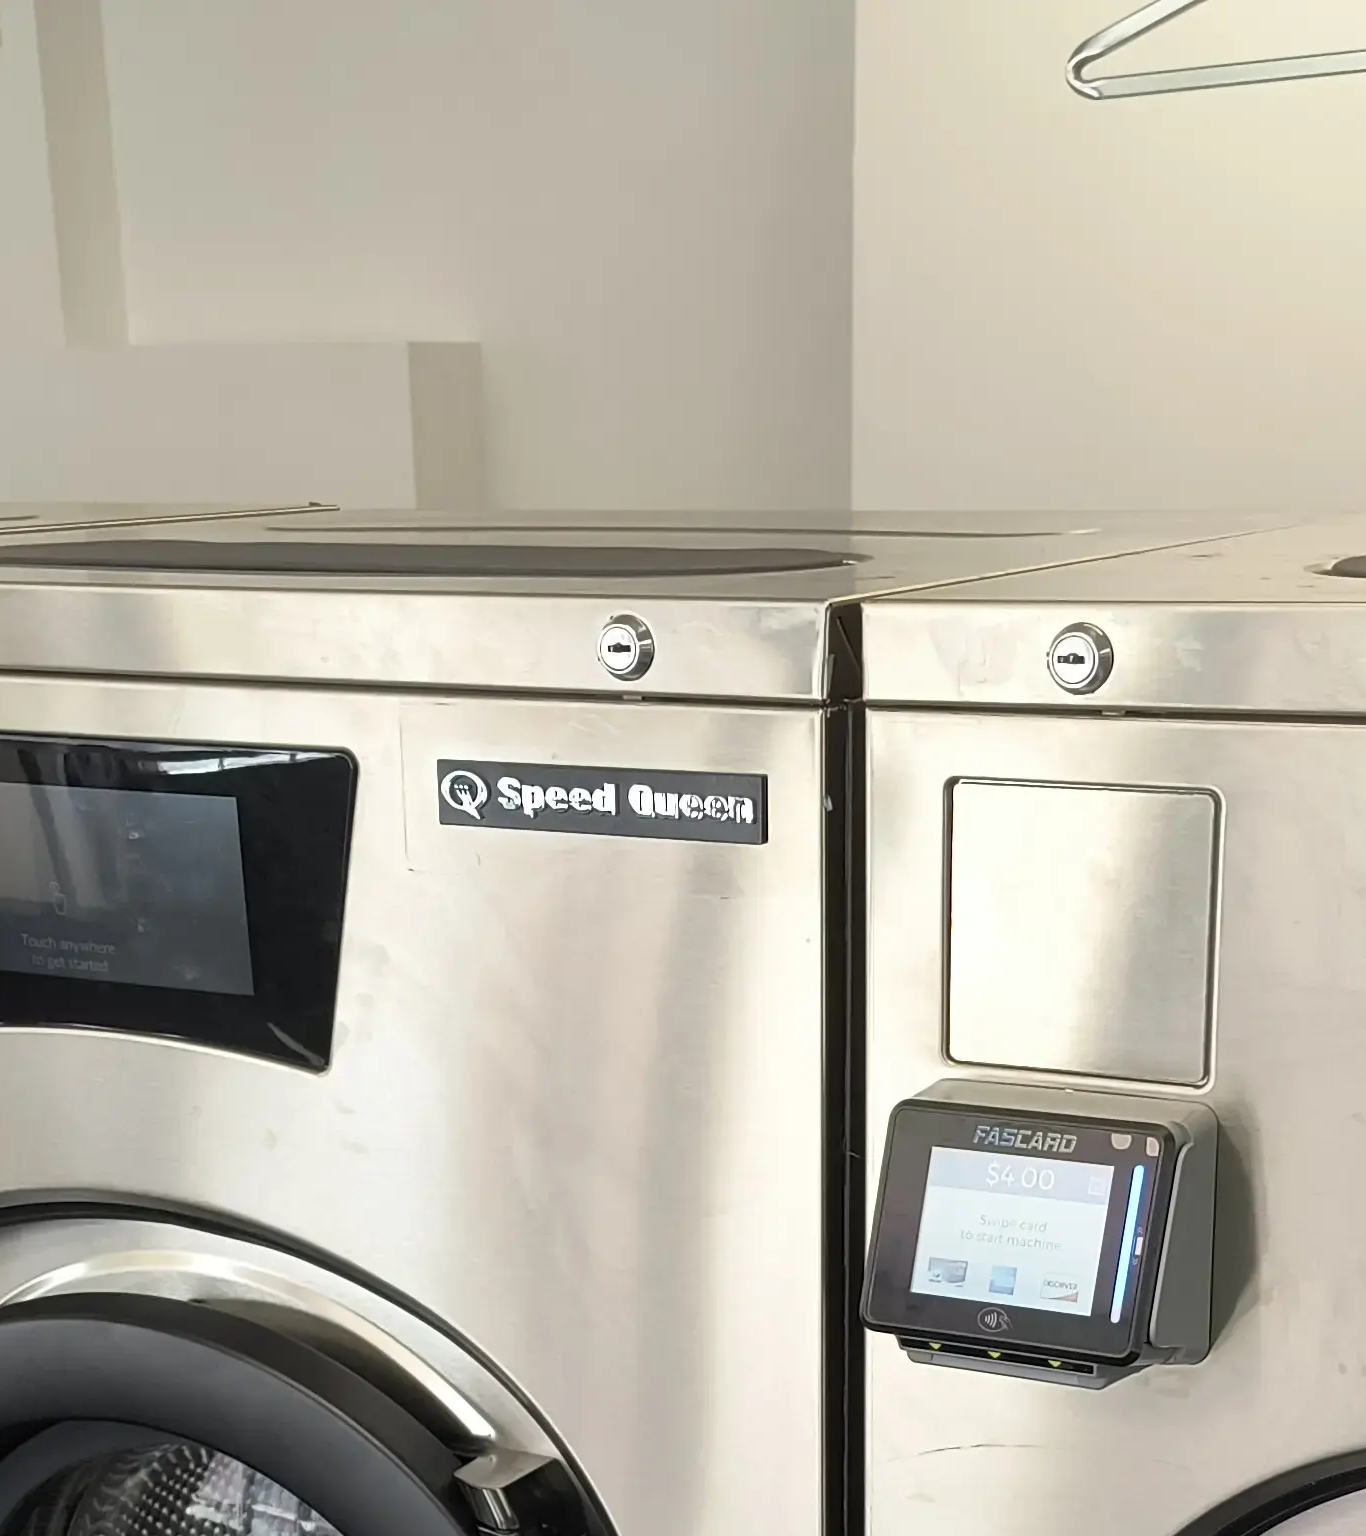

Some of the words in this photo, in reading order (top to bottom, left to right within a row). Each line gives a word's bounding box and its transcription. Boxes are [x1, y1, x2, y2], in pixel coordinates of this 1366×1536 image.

[497, 776, 616, 819] Speed
[628, 784, 754, 823] Queen
[20, 932, 57, 949] Touch
[972, 1125, 1078, 1154] FASCARD
[1019, 1220, 1048, 1233] card
[960, 1229, 974, 1240] to
[976, 1231, 1003, 1244] start
[1006, 1235, 1063, 1251] machine
